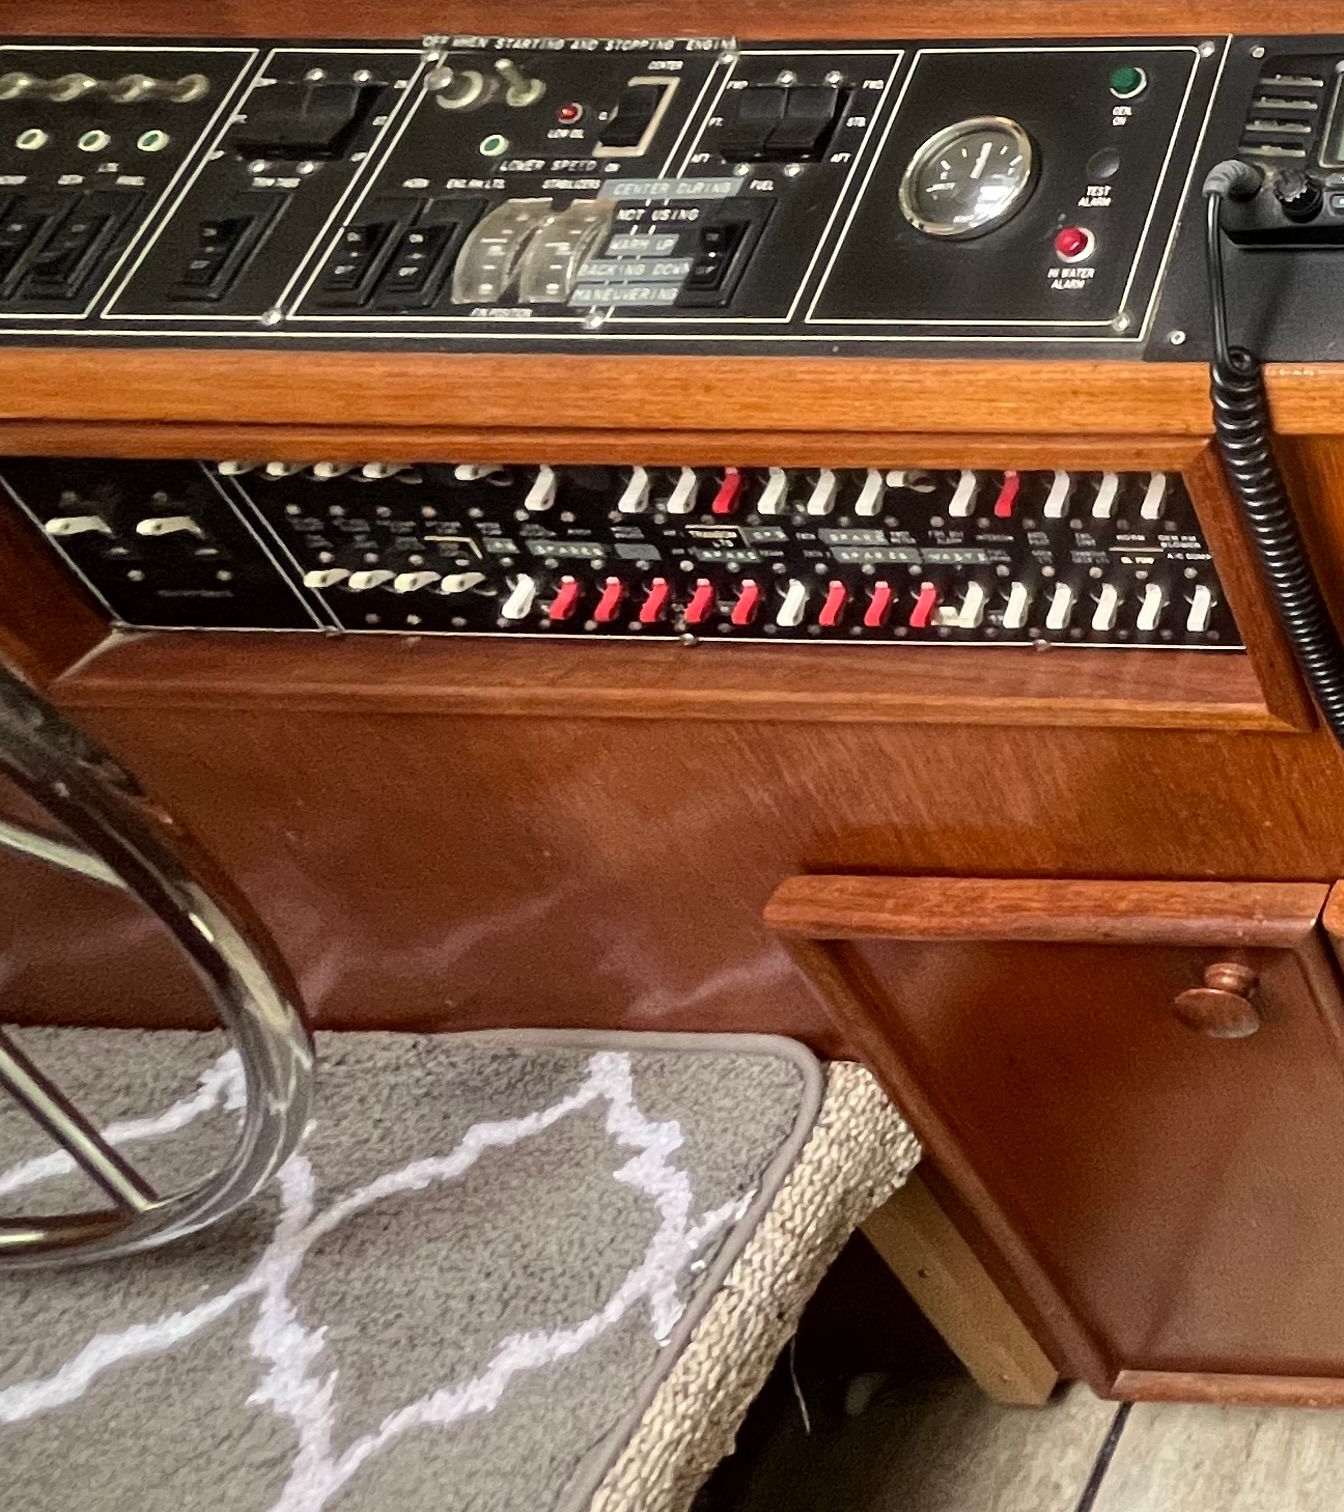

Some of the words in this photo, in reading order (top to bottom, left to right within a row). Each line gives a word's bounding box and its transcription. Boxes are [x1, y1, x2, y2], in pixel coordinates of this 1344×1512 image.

[494, 38, 565, 51] STARTING
[570, 39, 599, 51] AND
[605, 39, 675, 51] STOPPING
[613, 182, 671, 196] CENTER
[676, 181, 733, 195] DURING
[749, 179, 775, 191] FUEL
[1086, 185, 1112, 196] TEST
[1077, 196, 1112, 207] ALARM
[616, 208, 647, 221] NOT
[651, 208, 700, 222] USING
[608, 239, 651, 251] WARM
[655, 239, 675, 251] UP
[576, 263, 647, 278] BACKING
[1061, 267, 1096, 279] WATER
[1051, 278, 1086, 290] ALARM
